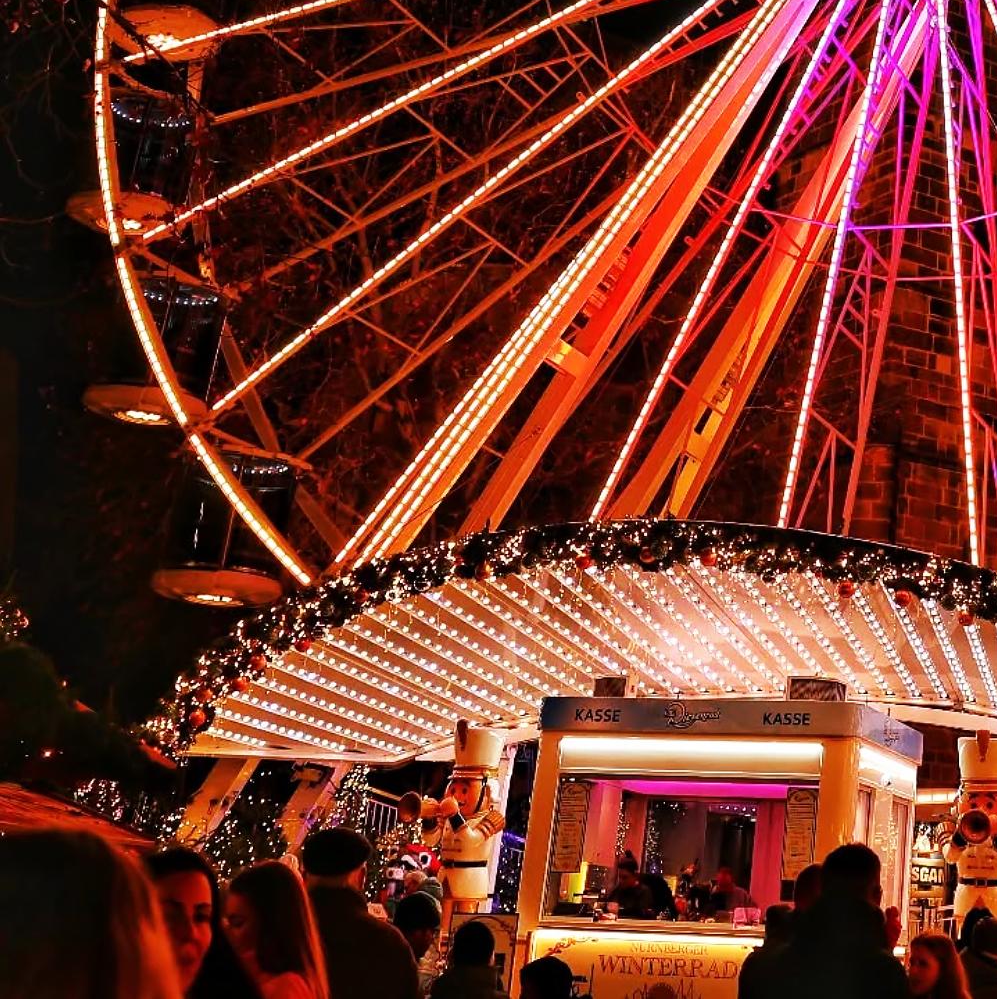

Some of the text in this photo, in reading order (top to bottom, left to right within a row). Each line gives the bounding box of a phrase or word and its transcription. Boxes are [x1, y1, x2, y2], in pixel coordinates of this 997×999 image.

[575, 708, 621, 722] KASSE
[763, 712, 811, 725] KASSE
[599, 955, 738, 979] WINTERRAD
